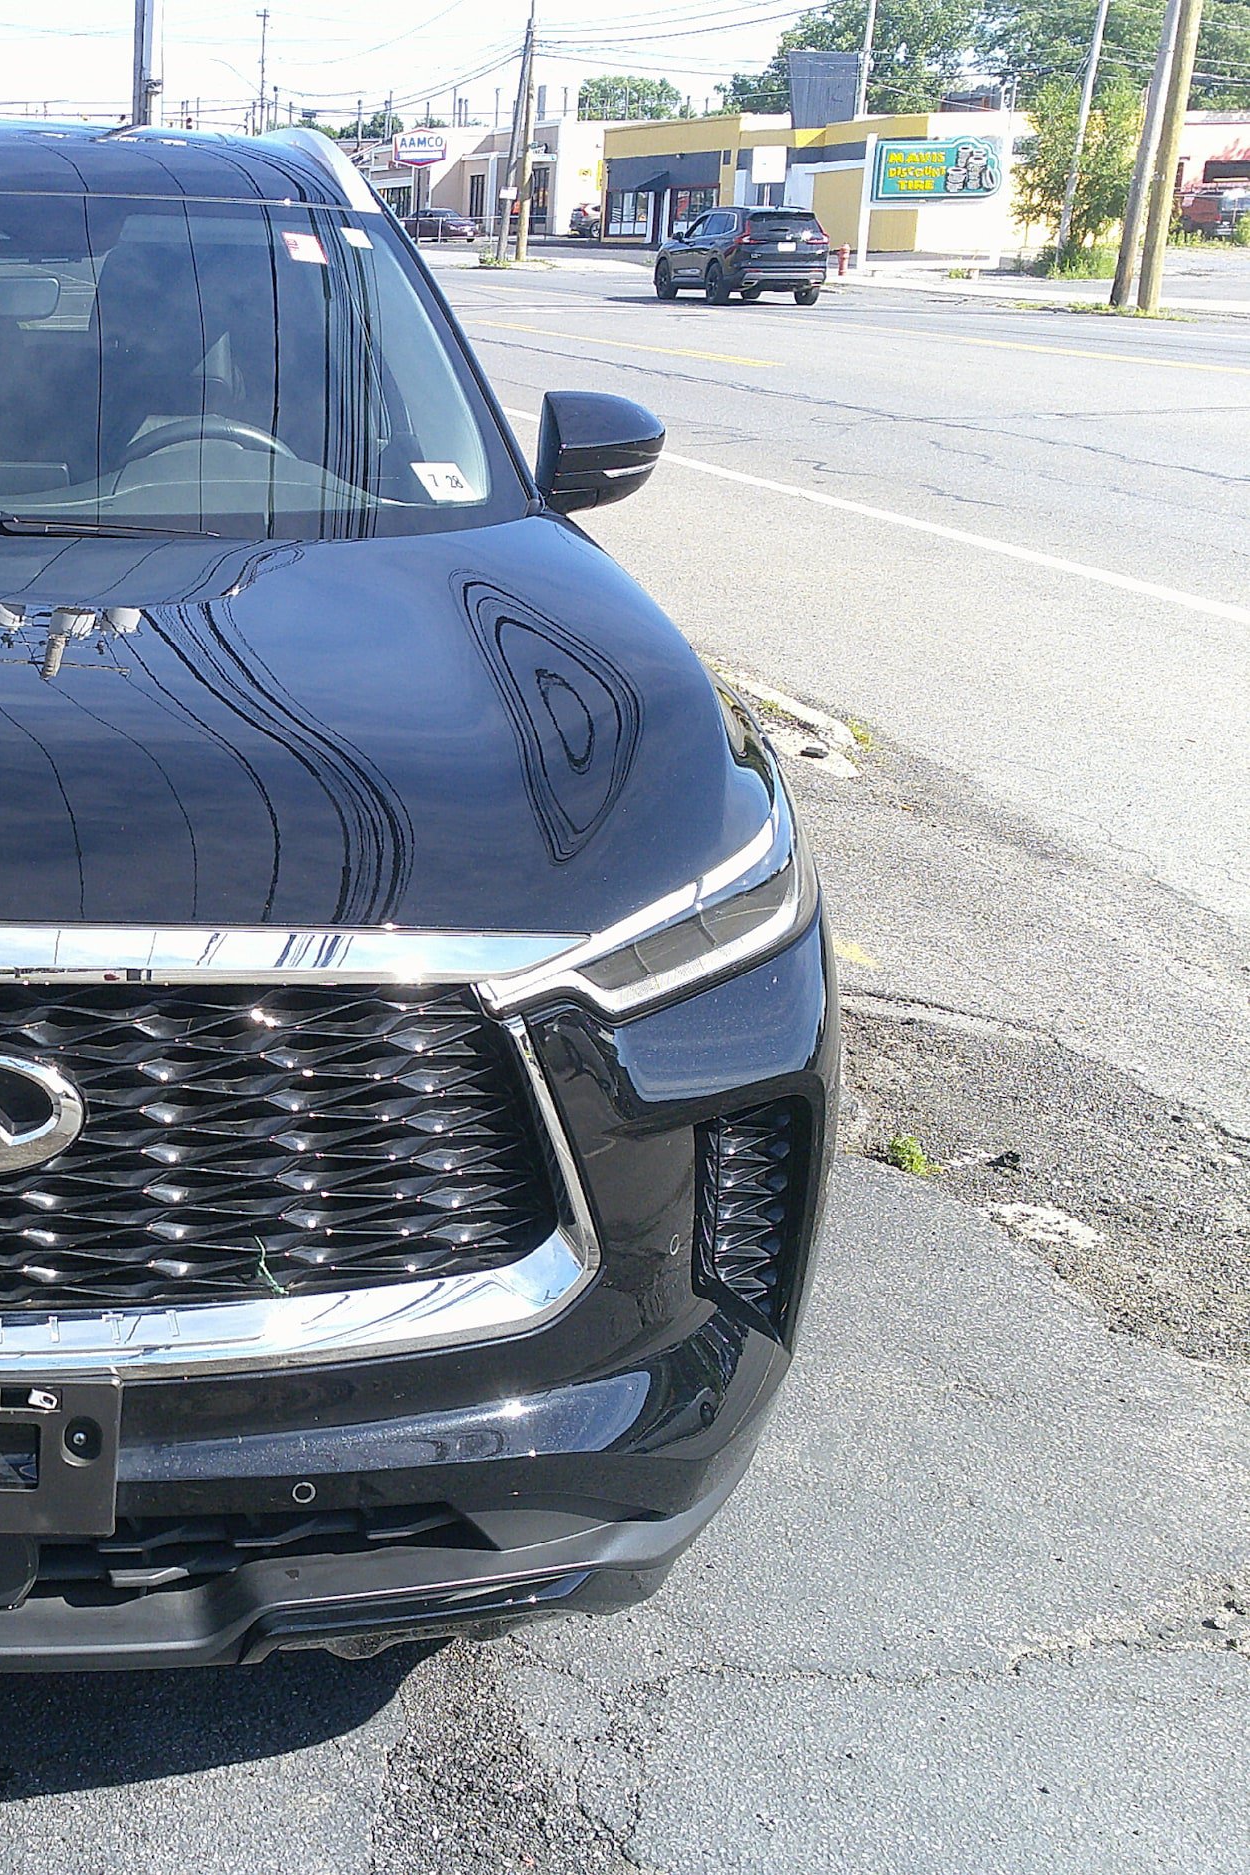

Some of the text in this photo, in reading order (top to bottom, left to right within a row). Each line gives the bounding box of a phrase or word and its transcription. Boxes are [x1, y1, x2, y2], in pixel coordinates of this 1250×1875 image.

[399, 136, 444, 148] AAMCO
[888, 152, 946, 163] MAVIS
[888, 166, 946, 178] DISCOUNT
[898, 180, 935, 191] TIRE
[427, 473, 439, 487] 7
